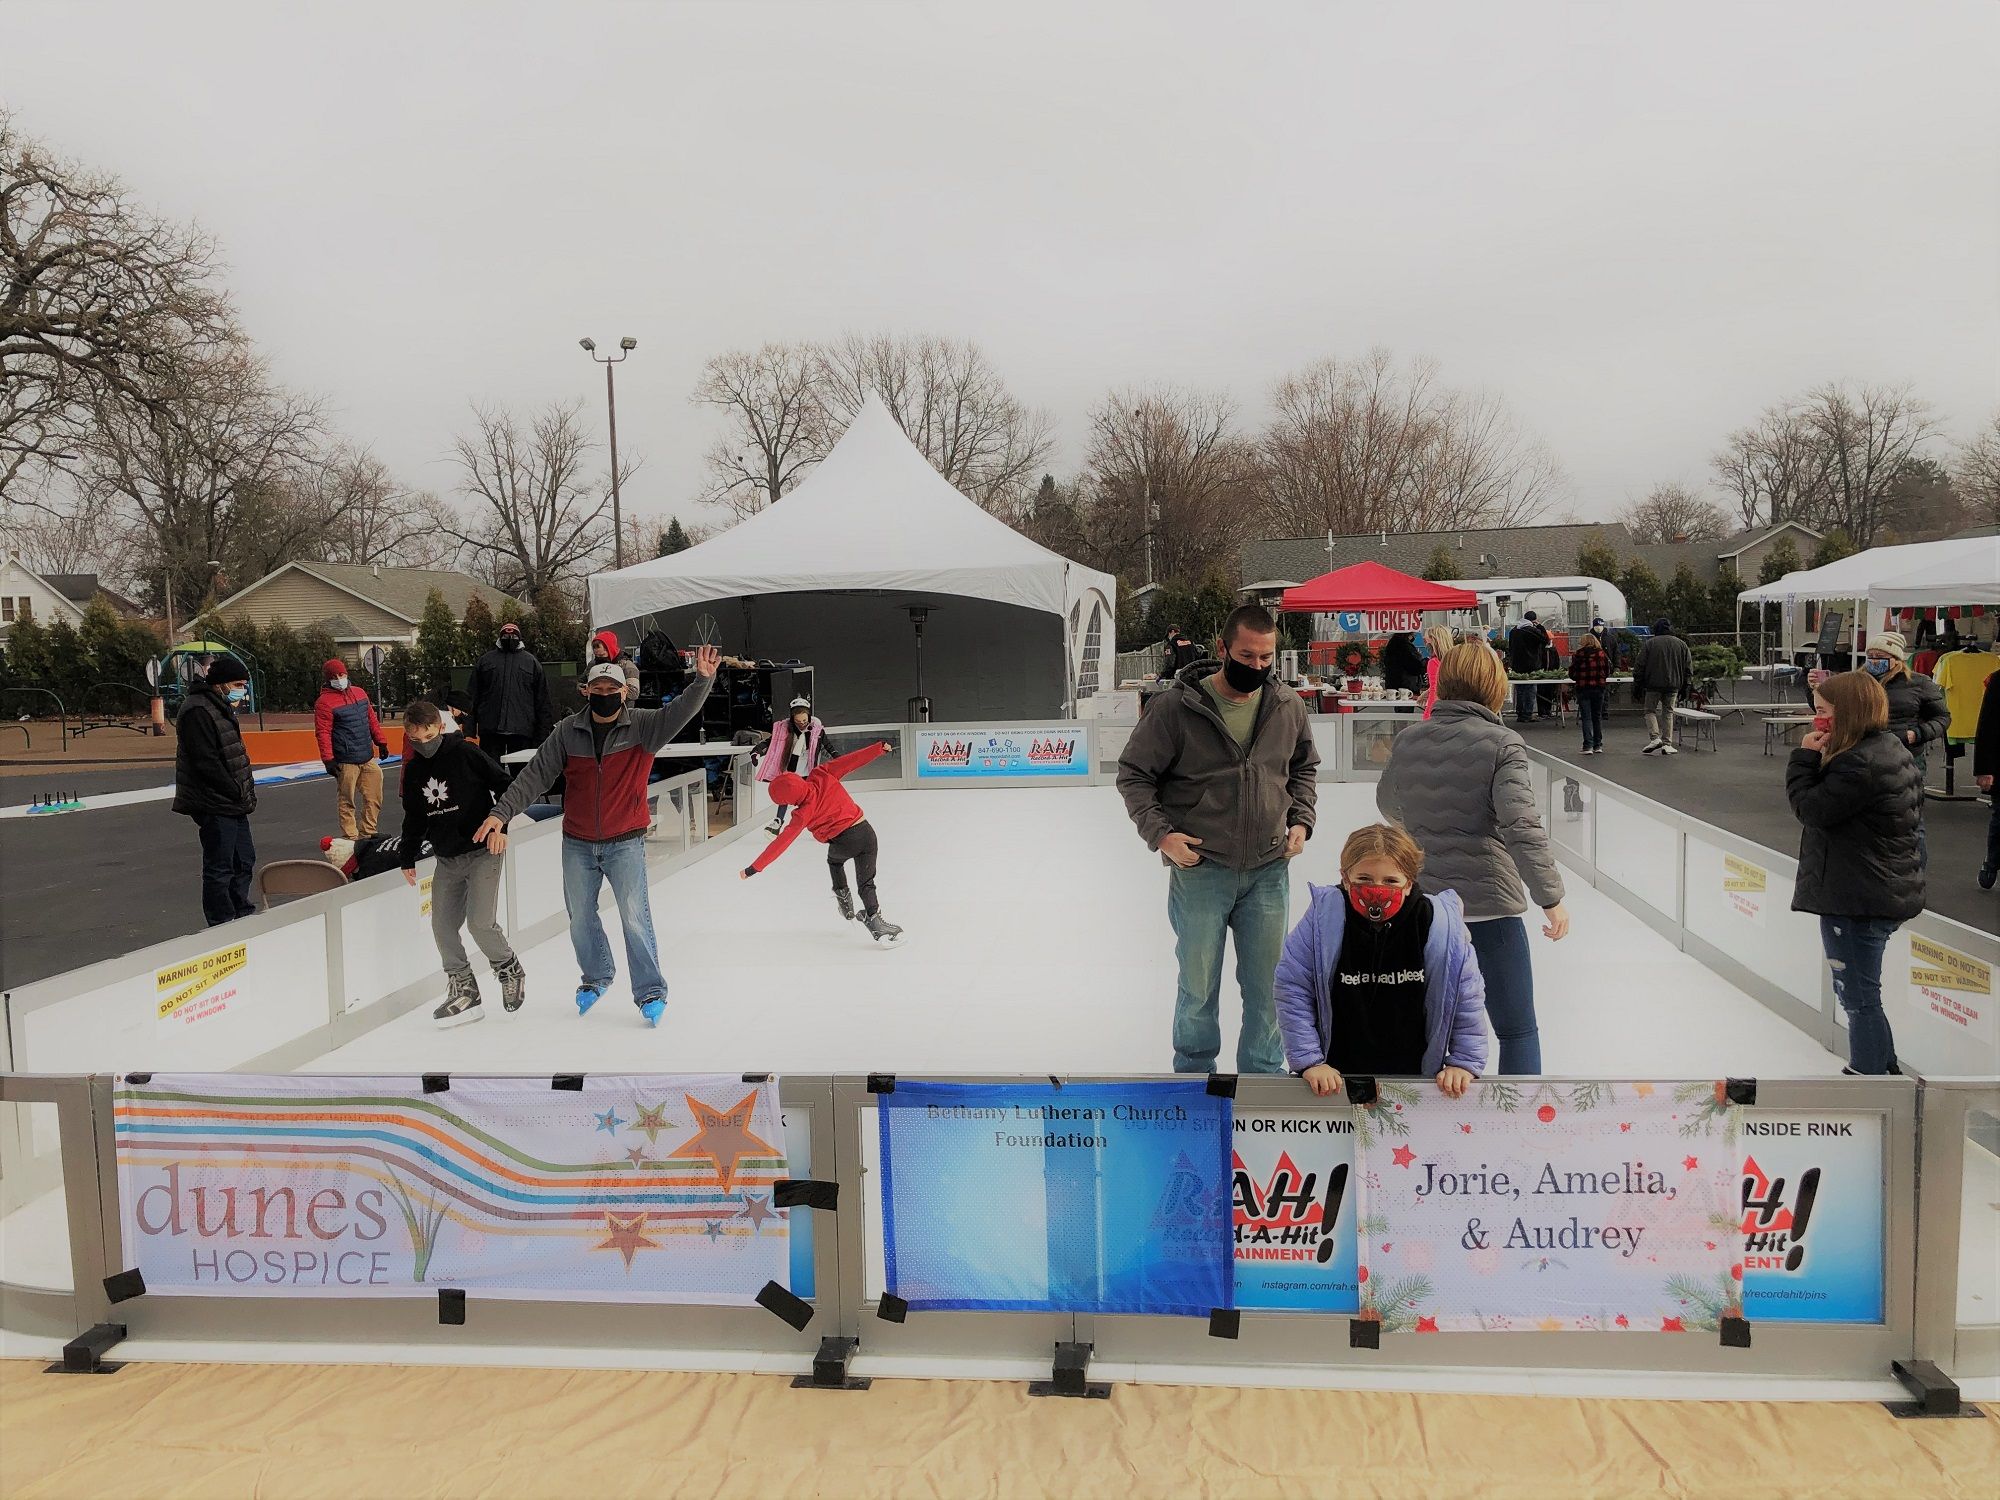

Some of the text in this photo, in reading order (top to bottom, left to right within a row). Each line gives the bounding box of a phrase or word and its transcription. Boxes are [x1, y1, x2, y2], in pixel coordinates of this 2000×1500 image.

[1366, 609, 1421, 631] TICKETS
[158, 948, 246, 985] WARNING DO NOT SIT
[1911, 940, 1990, 981] WARNING DO NOT SIT
[1912, 971, 1923, 980] DO
[1924, 972, 1938, 981] NOT
[1940, 974, 1952, 983] SIT
[160, 1000, 174, 1013] DO
[175, 988, 194, 1003] NOT
[195, 979, 208, 991] SIT
[173, 988, 237, 1019] DO NOT SIT OR LEAN
[1921, 986, 1978, 1020] DO NOT SIT OR LEAN
[185, 1003, 226, 1024] ON WINDOWS
[1930, 1002, 1967, 1026] ON WINDOWS
[927, 1104, 1187, 1124] Bethany Lutheran Church
[1251, 1119, 1276, 1133] OR
[1281, 1119, 1321, 1134] KICK
[1807, 1122, 1853, 1137] RINK
[995, 1131, 1107, 1148] Foundation
[1415, 1162, 1677, 1202] Jorie, Amelia,
[136, 1161, 387, 1240] dunes
[1461, 1217, 1646, 1257] & Audrey
[193, 1249, 391, 1285] HOSPICE
